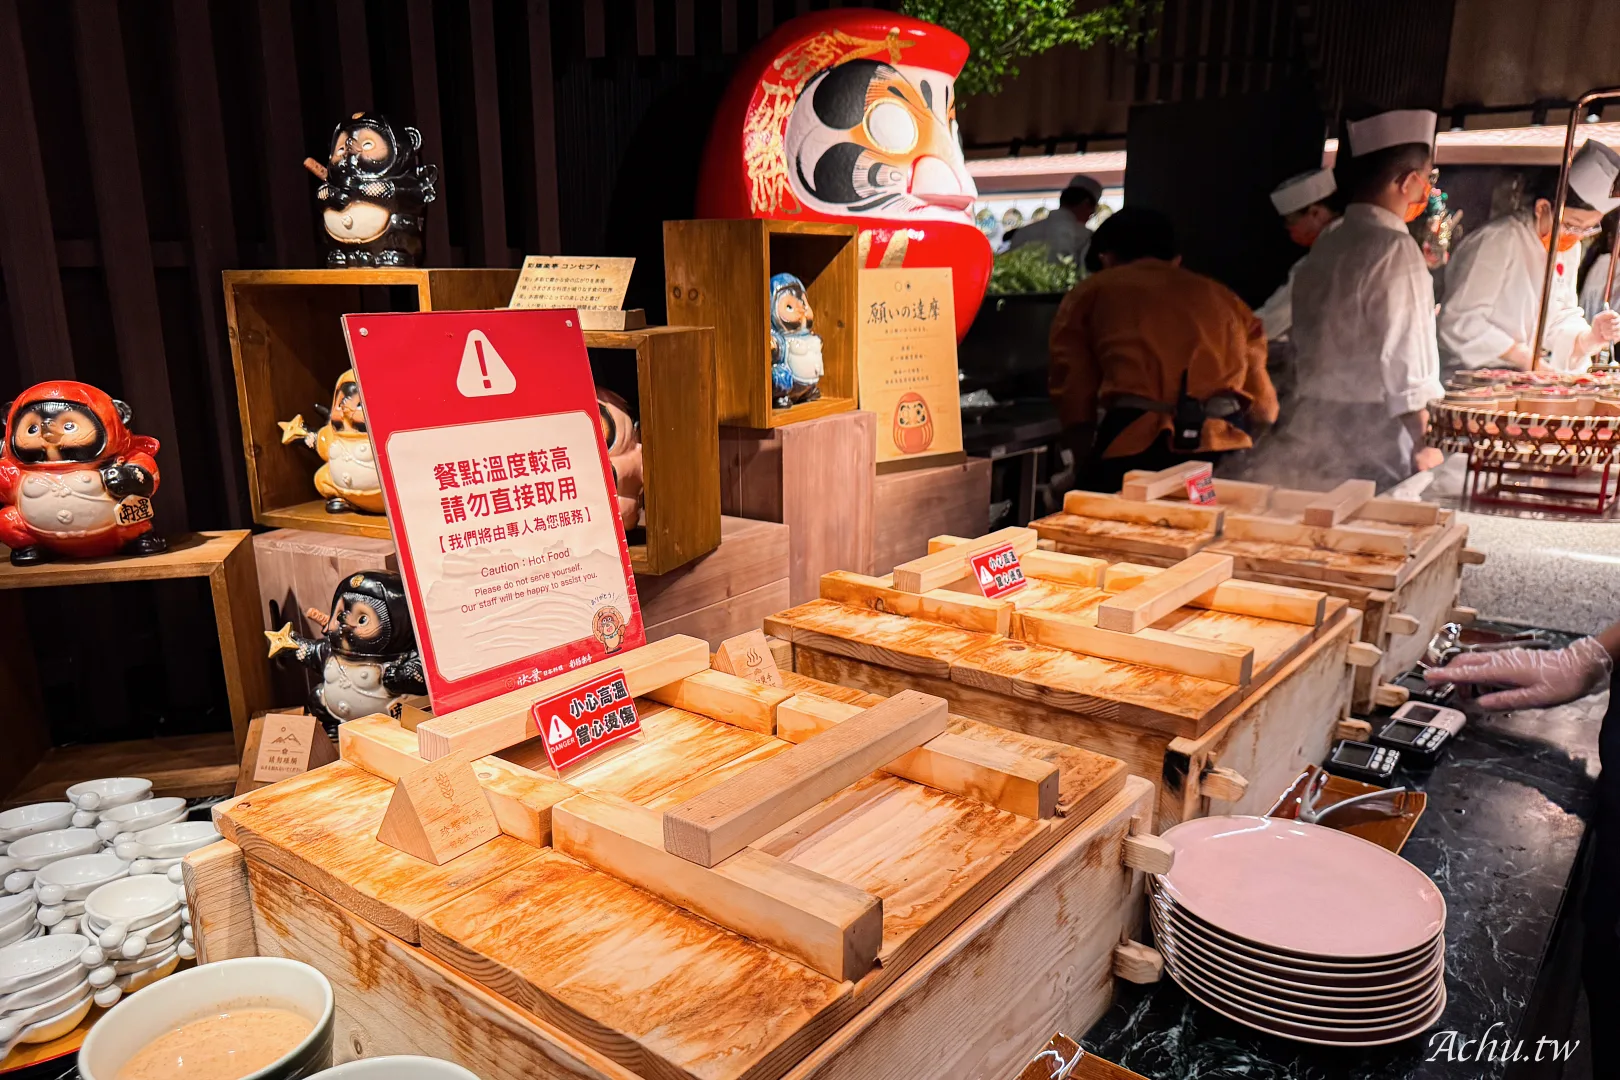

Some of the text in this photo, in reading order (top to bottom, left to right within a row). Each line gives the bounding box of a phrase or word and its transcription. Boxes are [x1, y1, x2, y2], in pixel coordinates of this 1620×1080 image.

[433, 446, 572, 491] 餐點溫度較高
[440, 476, 578, 525] 請勿直接取用
[474, 562, 583, 597] Please do not serve yourself.
[481, 560, 520, 578] Caution
[528, 555, 545, 567] Hot
[547, 547, 570, 562] Food
[460, 571, 598, 614] Our staff will be happy to assist you.
[570, 679, 629, 719] 小心高溫
[550, 736, 576, 754] DANGER
[575, 704, 637, 748] 當心燙傷
